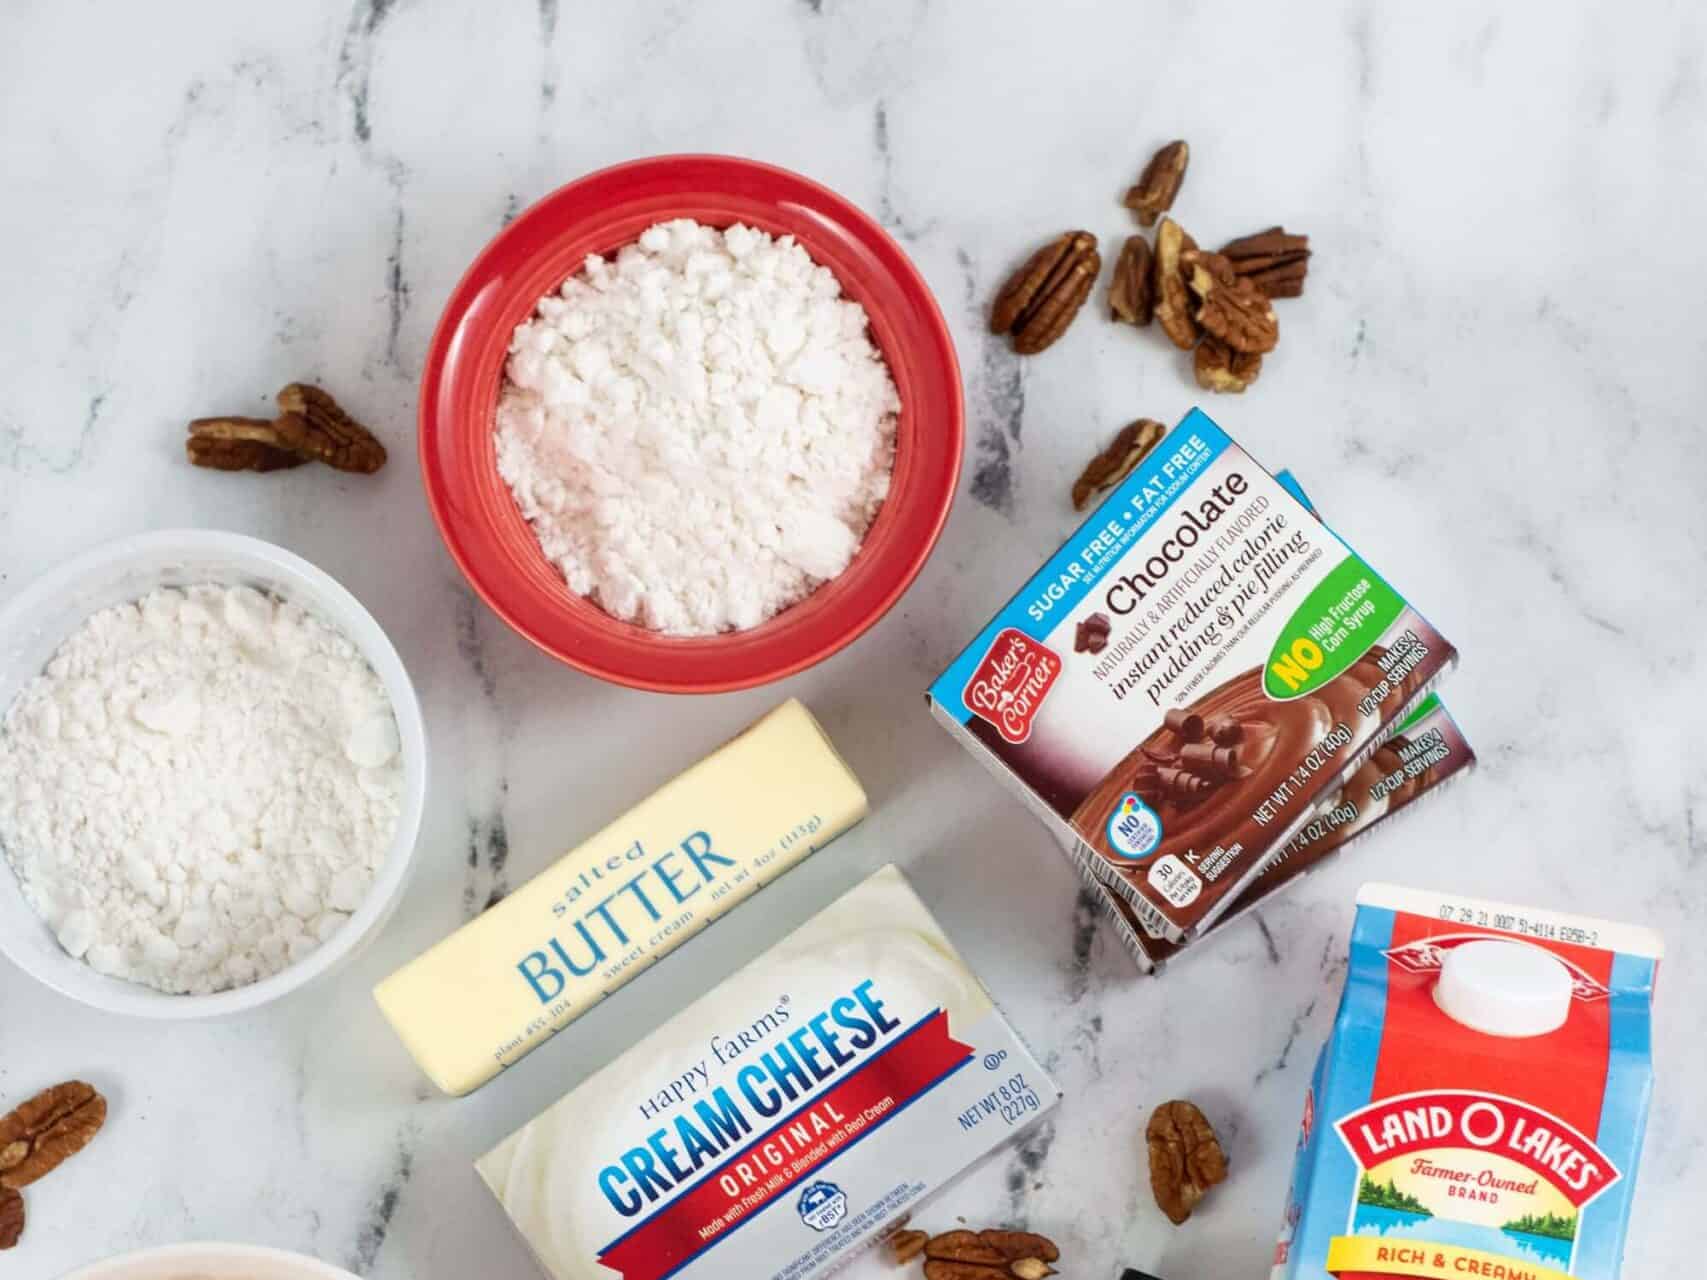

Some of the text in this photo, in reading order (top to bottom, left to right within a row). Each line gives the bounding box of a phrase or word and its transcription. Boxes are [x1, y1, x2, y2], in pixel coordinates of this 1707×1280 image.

[1027, 434, 1205, 620] SUGAR FREE FAT FREE
[1105, 473, 1248, 615] Chocolate
[1091, 495, 1269, 680] NATURALLY & ARTIFICIALLY FLAVORED
[1108, 514, 1284, 700] instant reduced calorie
[1146, 530, 1309, 706] pudding & pie filling
[1308, 578, 1370, 640] High Fructose
[1321, 599, 1375, 652] Corn Syrup
[1376, 637, 1412, 672] MAKES
[963, 637, 1034, 710] Baker's
[1002, 656, 1067, 735] Corner
[1271, 637, 1323, 690] NO
[1385, 640, 1431, 686] SERVINGS
[1252, 799, 1276, 826] NET
[1269, 782, 1293, 805] WT
[1289, 765, 1311, 786] 1.4
[1305, 749, 1325, 770] OZ
[1315, 723, 1357, 756] (40g)
[1397, 732, 1434, 763] MAKES
[1117, 815, 1139, 837] NO
[1305, 819, 1327, 841] OZ
[1322, 799, 1360, 832] (40g)
[552, 840, 644, 918] salted
[1156, 863, 1173, 880] 30
[517, 831, 734, 1003] BUTTER
[600, 908, 695, 980] sweet cream
[1438, 905, 1454, 919] 07
[598, 979, 900, 1216] CREAM CHEESE
[957, 1072, 1028, 1130] NET WT 8 OZ
[999, 1088, 1040, 1125] (227g)
[696, 1215, 726, 1241] Made
[720, 1200, 745, 1223] with
[739, 1183, 769, 1209] Fresh
[763, 1170, 786, 1192] Milk
[788, 1141, 827, 1174] Blended
[820, 1125, 847, 1150] with
[842, 1112, 866, 1134] Real
[860, 1091, 895, 1122] Cream
[719, 1101, 844, 1196] ORIGINAL
[1361, 1102, 1599, 1191] LAND O LAKES
[1408, 1157, 1540, 1195] Farmer-Owned
[1447, 1184, 1498, 1204] BRAND
[1375, 1246, 1424, 1264] RICH
[1432, 1252, 1445, 1268] &
